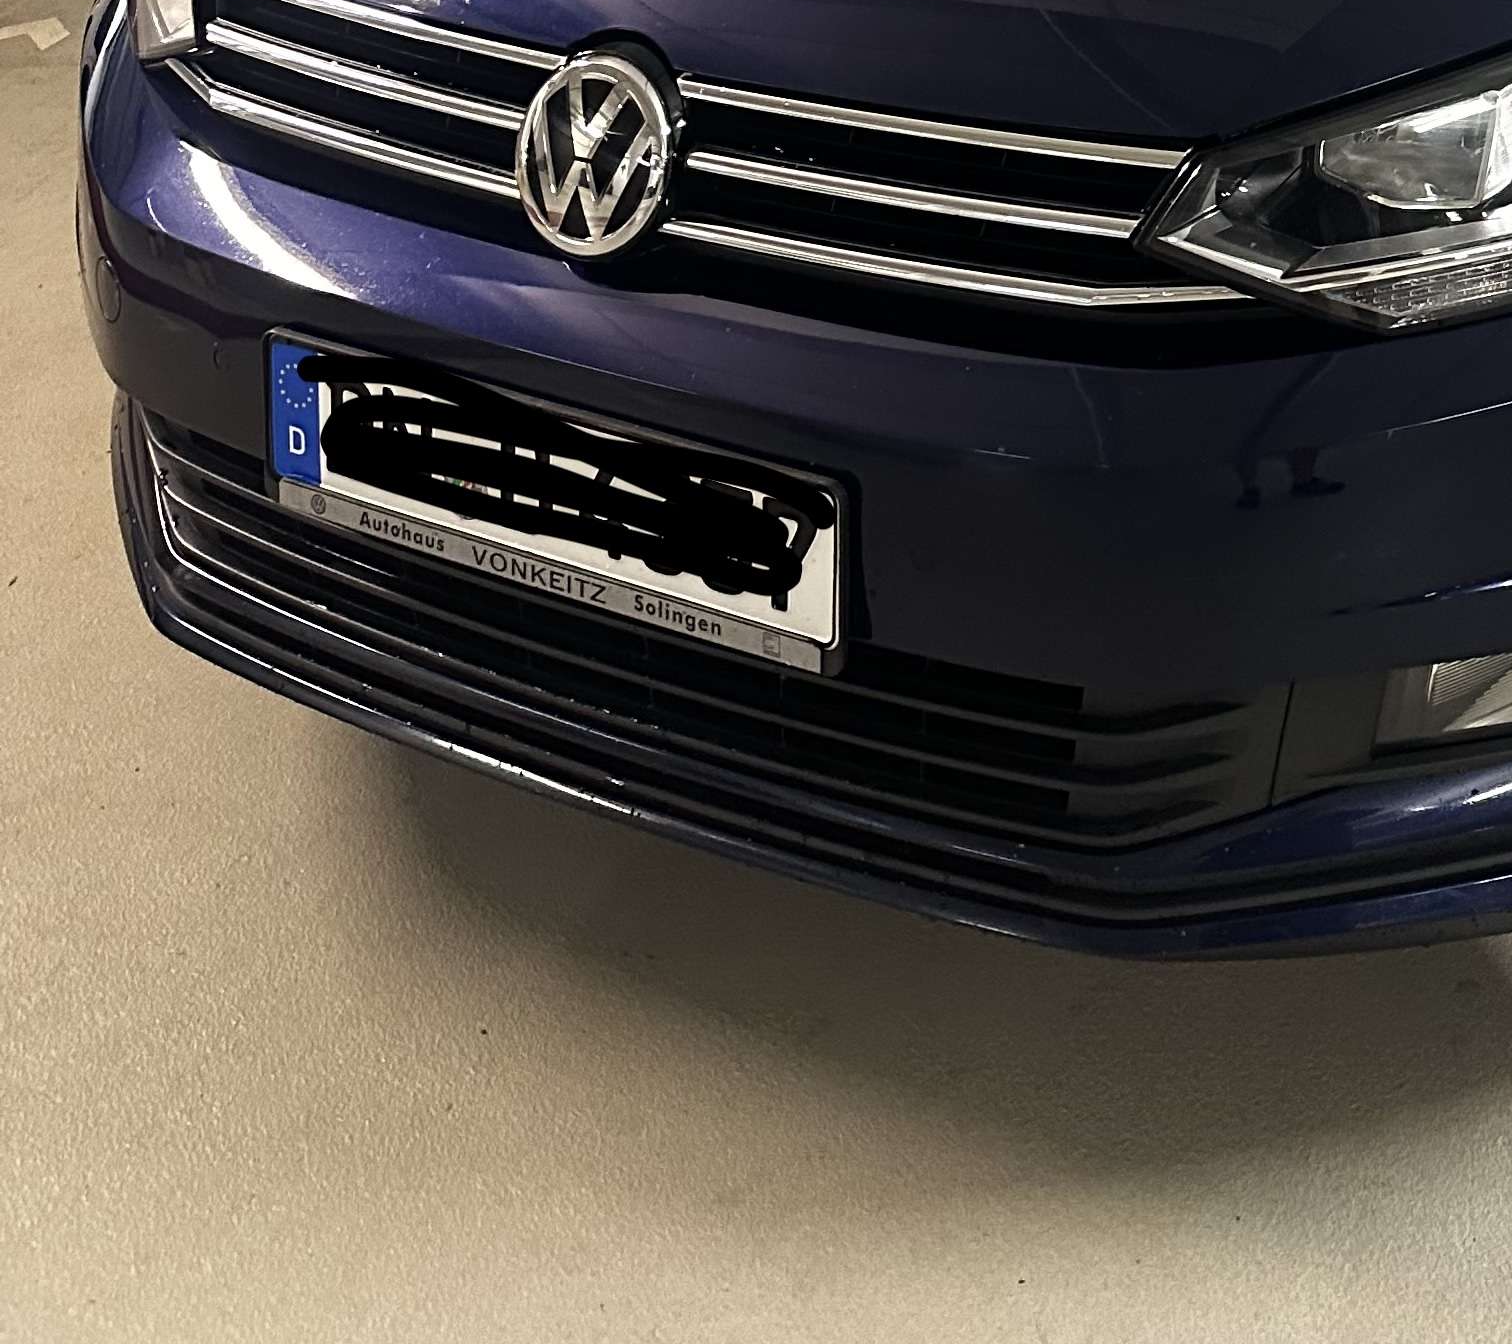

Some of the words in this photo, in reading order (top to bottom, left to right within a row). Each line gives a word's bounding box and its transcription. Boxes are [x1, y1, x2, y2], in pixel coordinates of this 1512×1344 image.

[288, 424, 306, 455] D
[359, 511, 445, 552] Autohaus
[472, 544, 607, 604] VONKEITZ
[634, 594, 722, 636] Solingen
